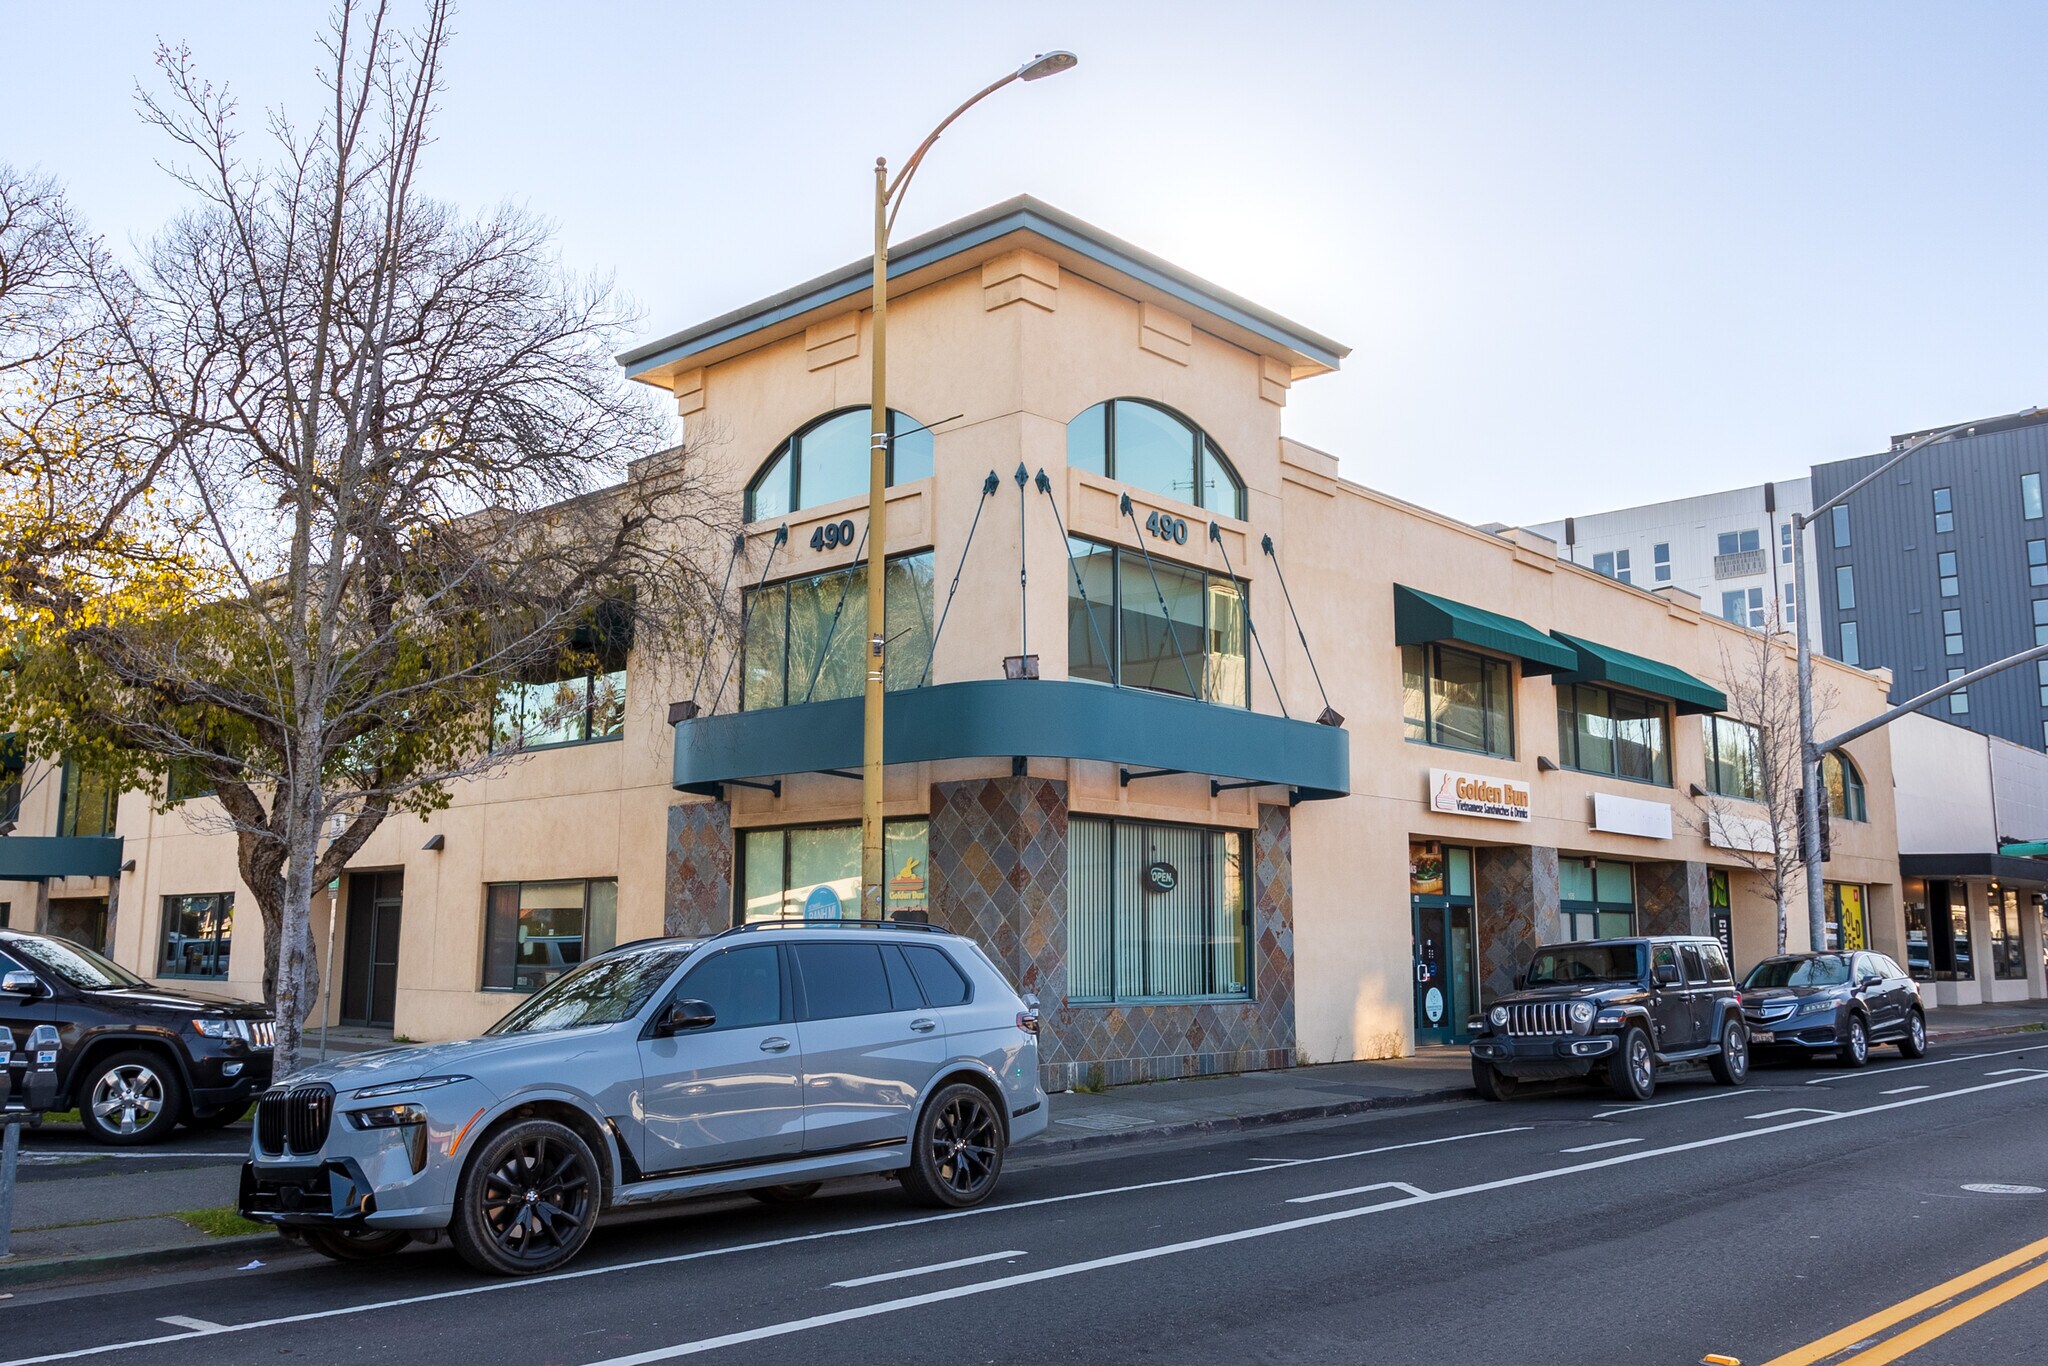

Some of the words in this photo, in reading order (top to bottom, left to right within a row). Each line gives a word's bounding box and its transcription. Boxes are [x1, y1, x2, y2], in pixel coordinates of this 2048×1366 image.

[810, 519, 855, 552] 490
[1146, 511, 1188, 545] 490
[1456, 777, 1502, 803] Golden
[1504, 784, 1529, 807] Bun
[1456, 800, 1484, 813] Vietnamese
[1484, 803, 1509, 816] Sandwiches
[1514, 810, 1528, 818] Drinks
[1152, 872, 1172, 882] OPEN
[889, 890, 911, 900] Golden
[912, 889, 925, 899] Bun
